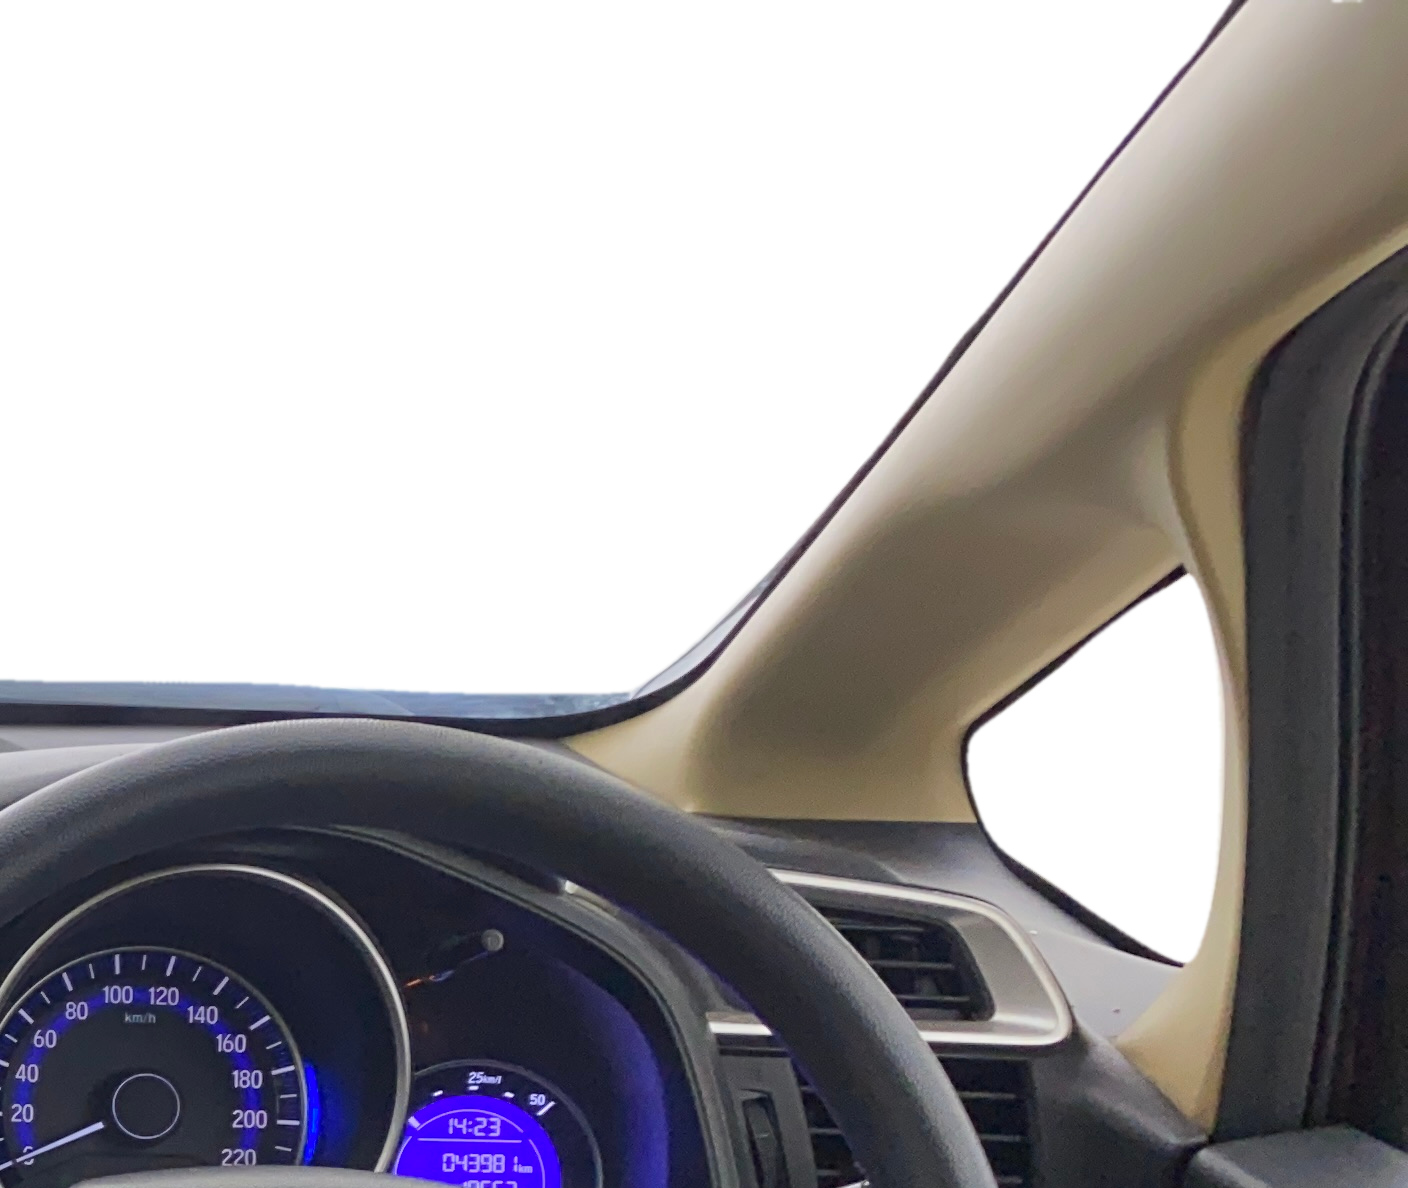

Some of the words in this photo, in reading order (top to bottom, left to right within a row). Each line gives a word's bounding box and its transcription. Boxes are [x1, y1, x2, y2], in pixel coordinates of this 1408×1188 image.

[102, 985, 133, 1004] 100
[148, 987, 179, 1006] 120
[65, 1002, 88, 1020] 80
[124, 1012, 156, 1024] km/h
[187, 1006, 218, 1025] 140
[33, 1030, 57, 1048] 60
[216, 1034, 247, 1053] 160
[15, 1064, 39, 1083] 40
[232, 1070, 263, 1089] 180
[529, 1093, 546, 1106] 50
[11, 1104, 34, 1122] 20
[232, 1110, 268, 1129] 200
[448, 1117, 501, 1136] 14:23
[221, 1148, 257, 1167] 220
